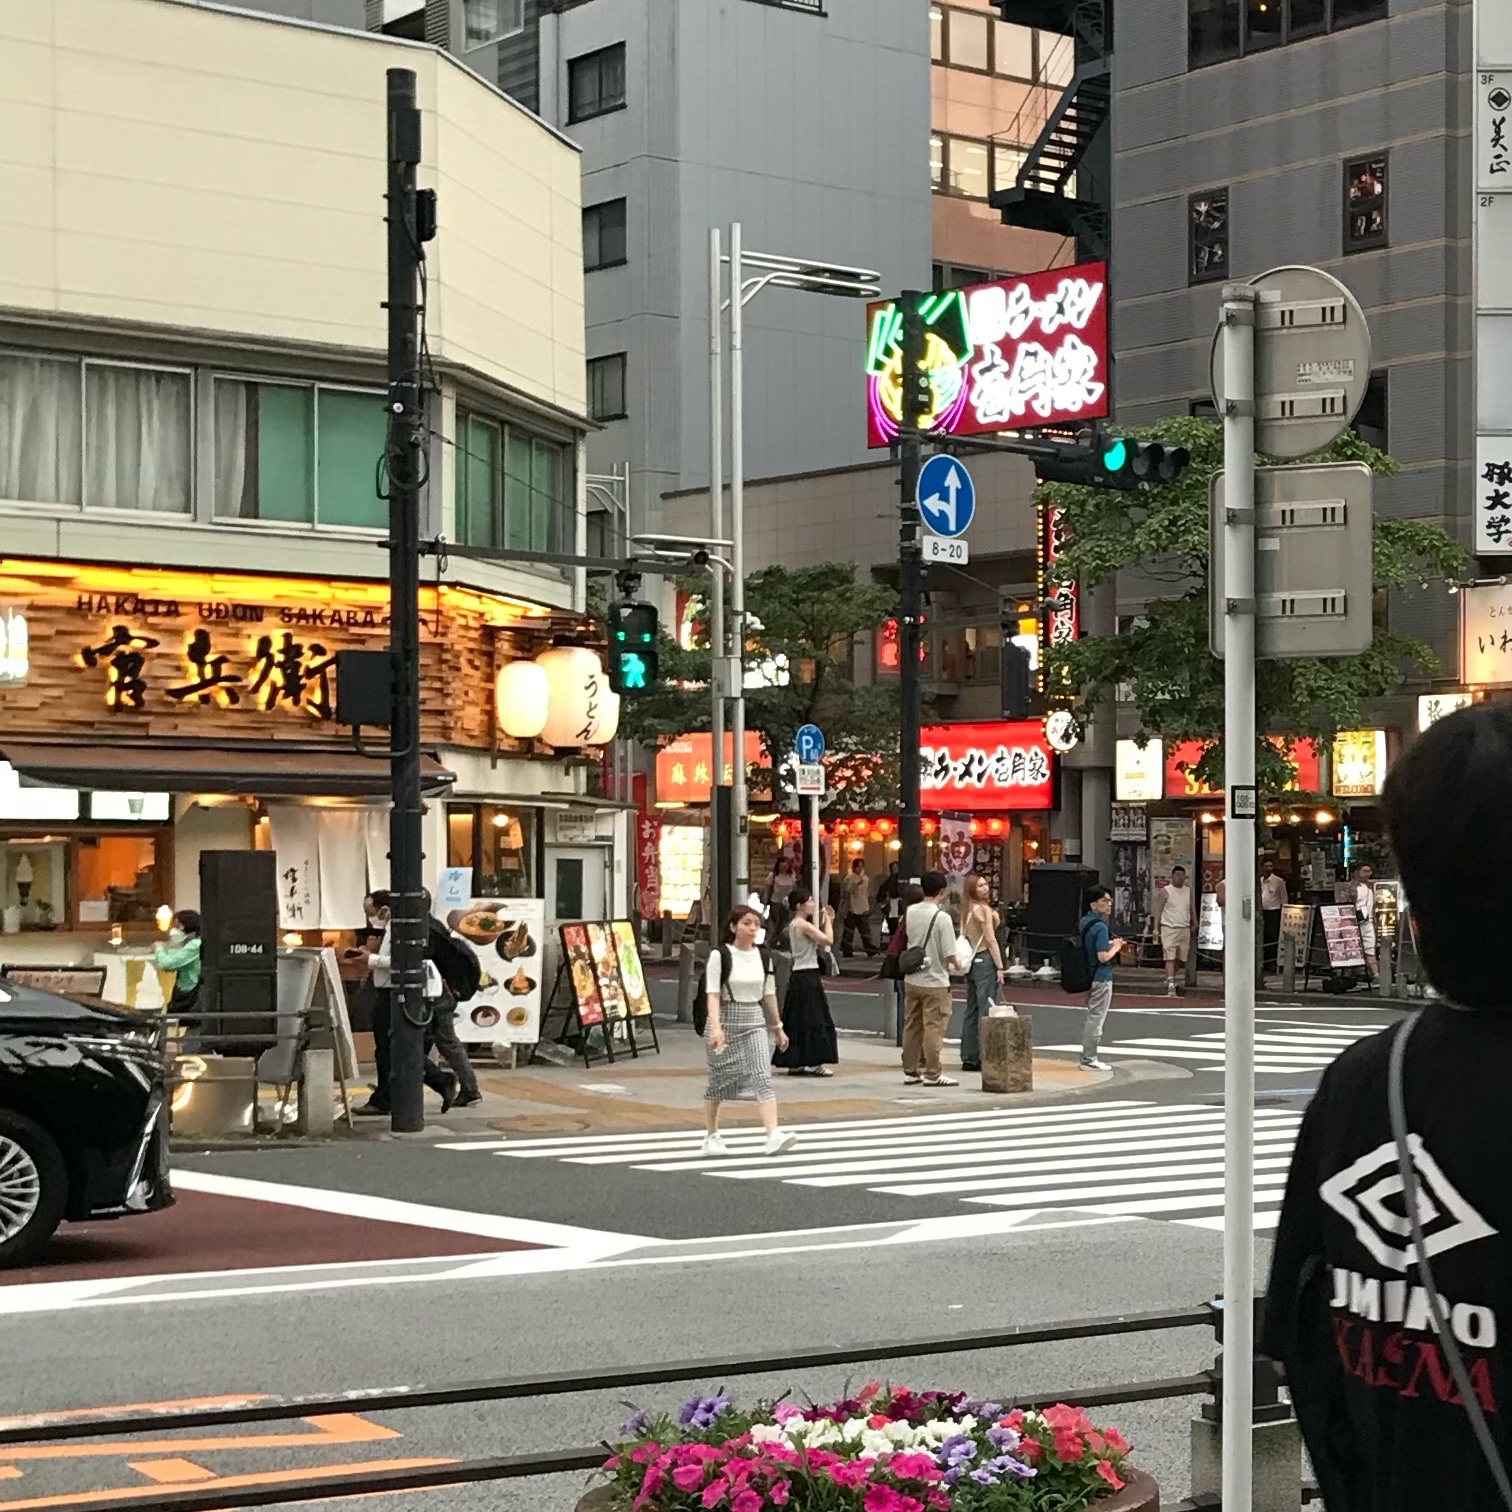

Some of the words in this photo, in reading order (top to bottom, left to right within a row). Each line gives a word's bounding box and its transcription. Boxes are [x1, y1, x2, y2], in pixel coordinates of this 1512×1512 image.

[1481, 75, 1494, 85] 3F
[1480, 197, 1494, 207] 2F
[932, 542, 962, 559] 8-20
[77, 594, 180, 617] HAKATA
[198, 602, 264, 623] UDON
[279, 607, 375, 629] SAKABA
[80, 624, 337, 720] 官兵衛
